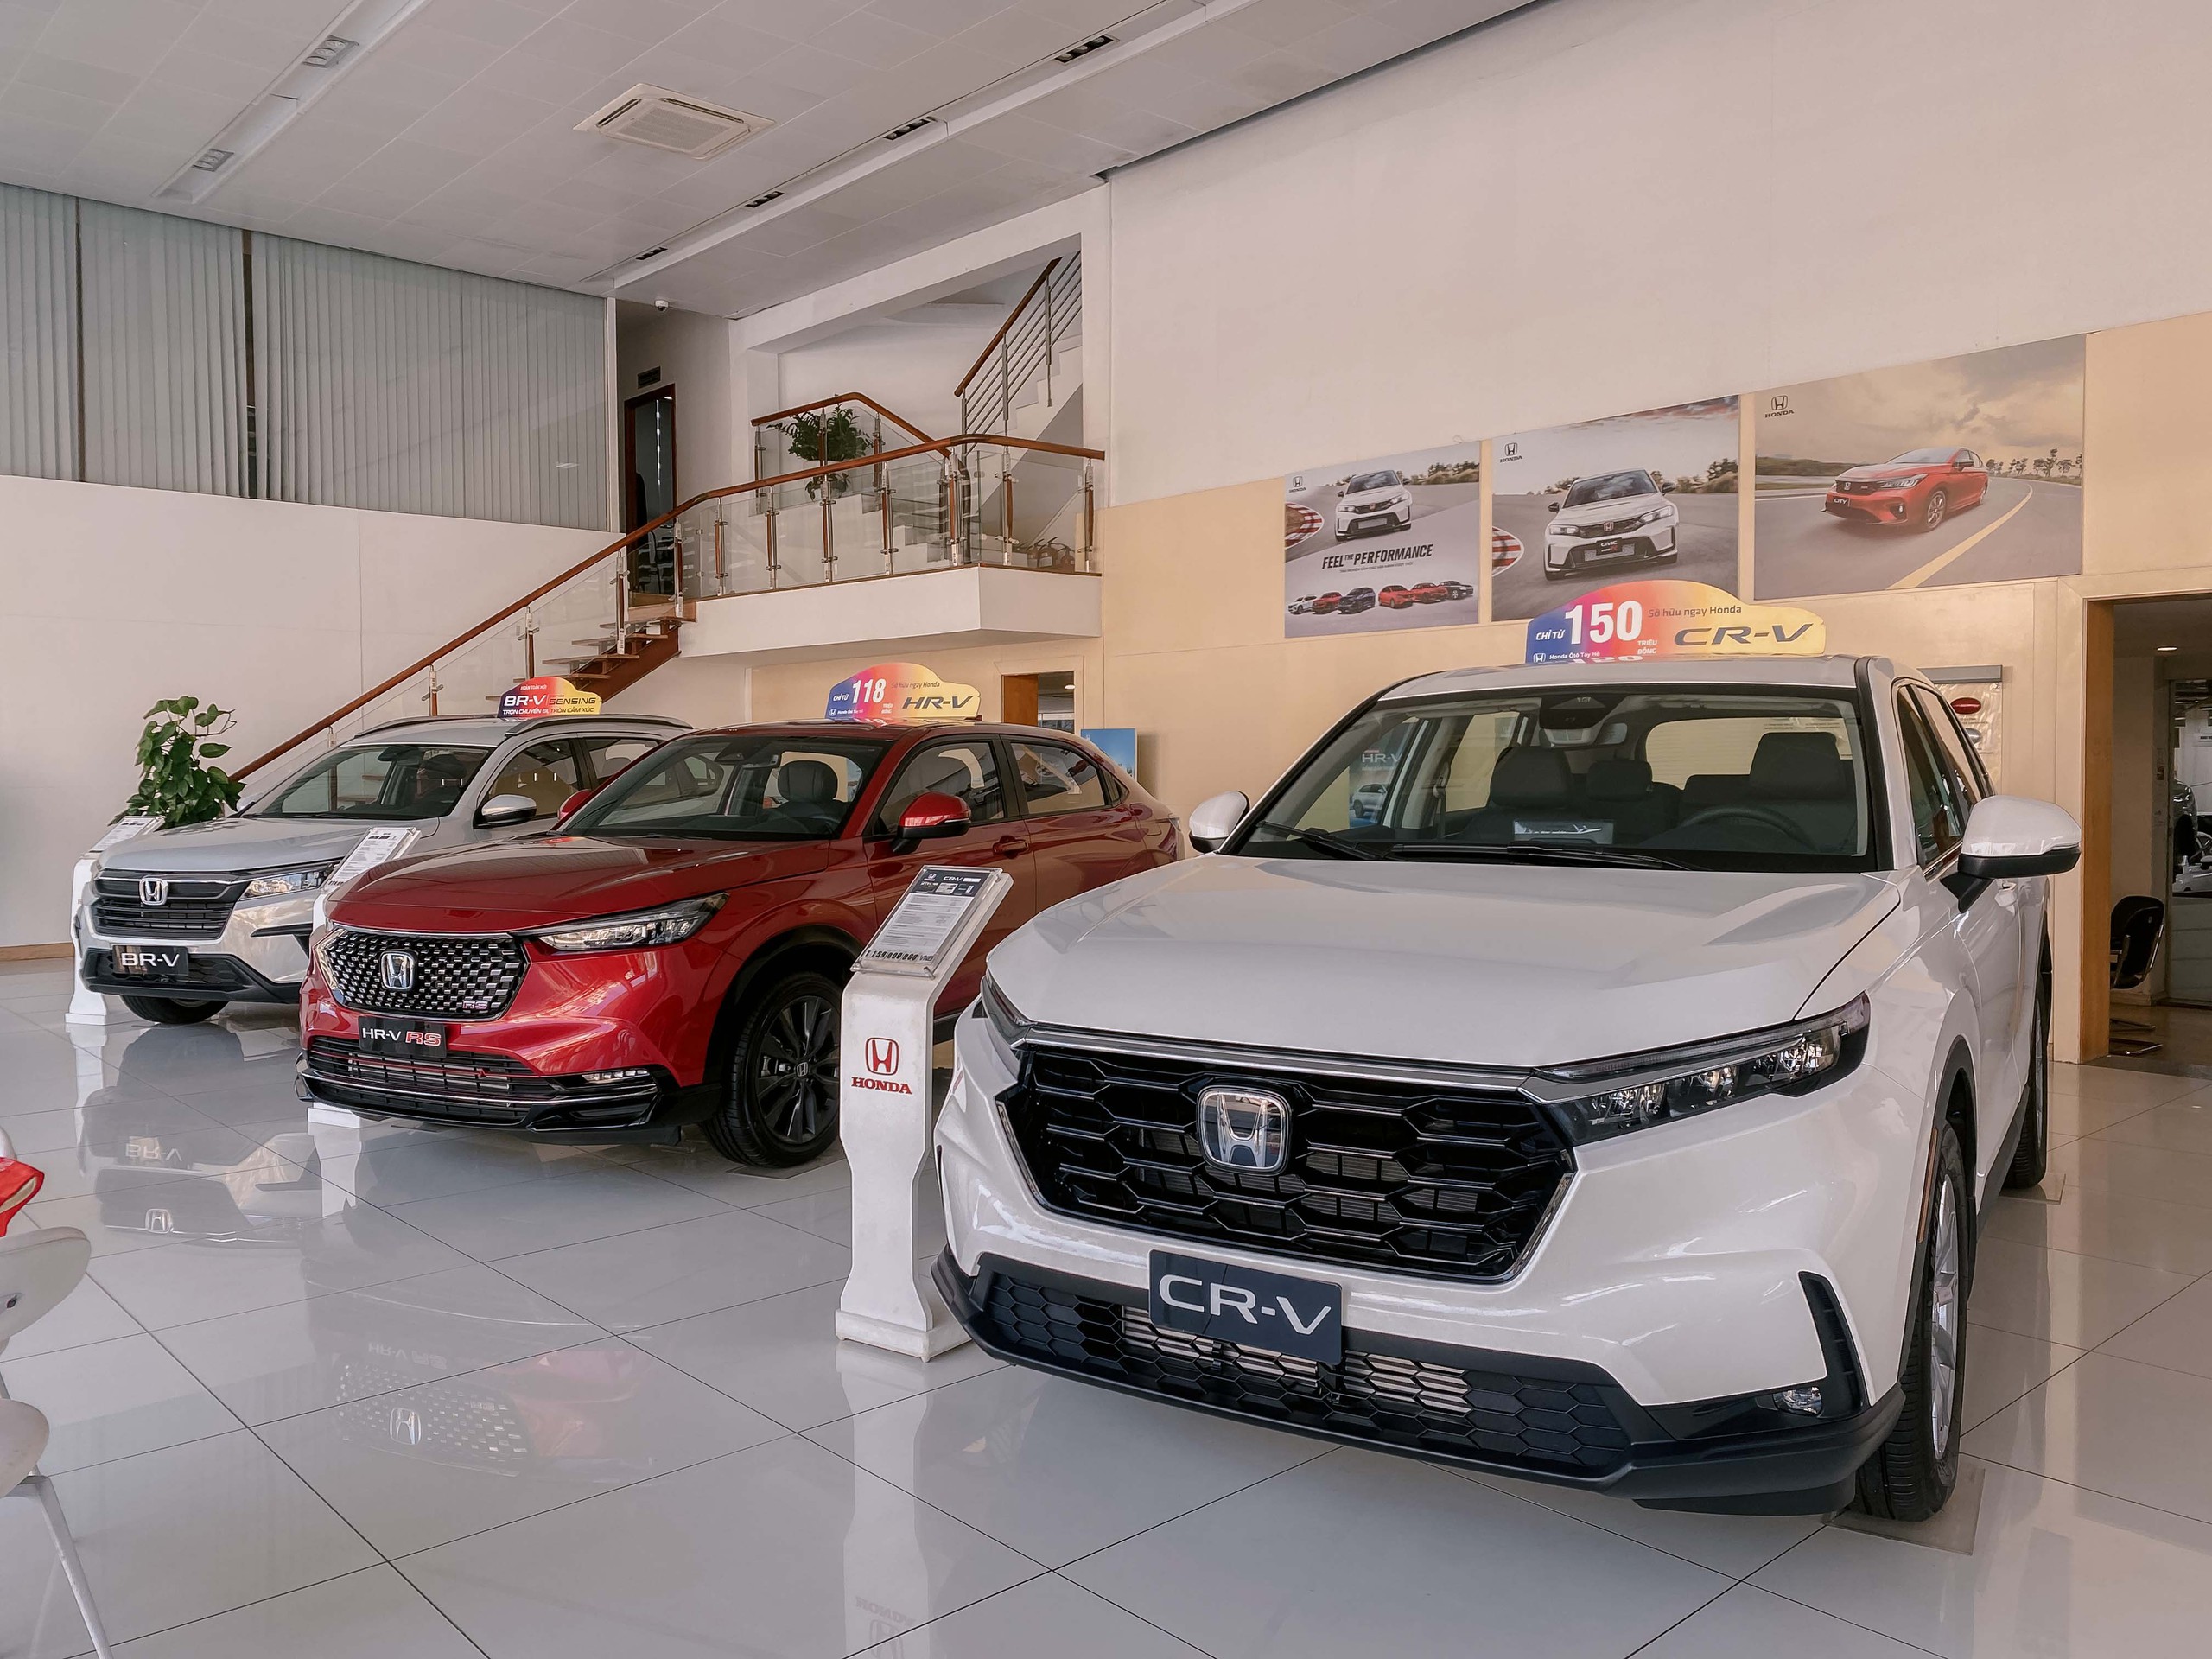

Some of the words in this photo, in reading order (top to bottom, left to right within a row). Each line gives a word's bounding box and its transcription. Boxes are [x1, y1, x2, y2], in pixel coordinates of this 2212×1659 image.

[1765, 410, 1795, 418] HONDA
[1322, 555, 1344, 569] FEEL
[1353, 543, 1433, 565] PERFORMANCE
[1683, 607, 1707, 619] ngay
[1709, 605, 1742, 615] Honda
[1565, 600, 1643, 645] 150
[1674, 623, 1814, 646] CR-V
[852, 679, 887, 703] 118
[504, 695, 547, 707] BR-V
[902, 696, 974, 709] HR-V
[121, 952, 180, 968] BR-V
[463, 1001, 488, 1009] RS
[362, 1027, 401, 1041] HR-V
[405, 1031, 442, 1046] RS
[851, 1077, 912, 1095] HONDA
[1159, 1274, 1332, 1335] CR-V
